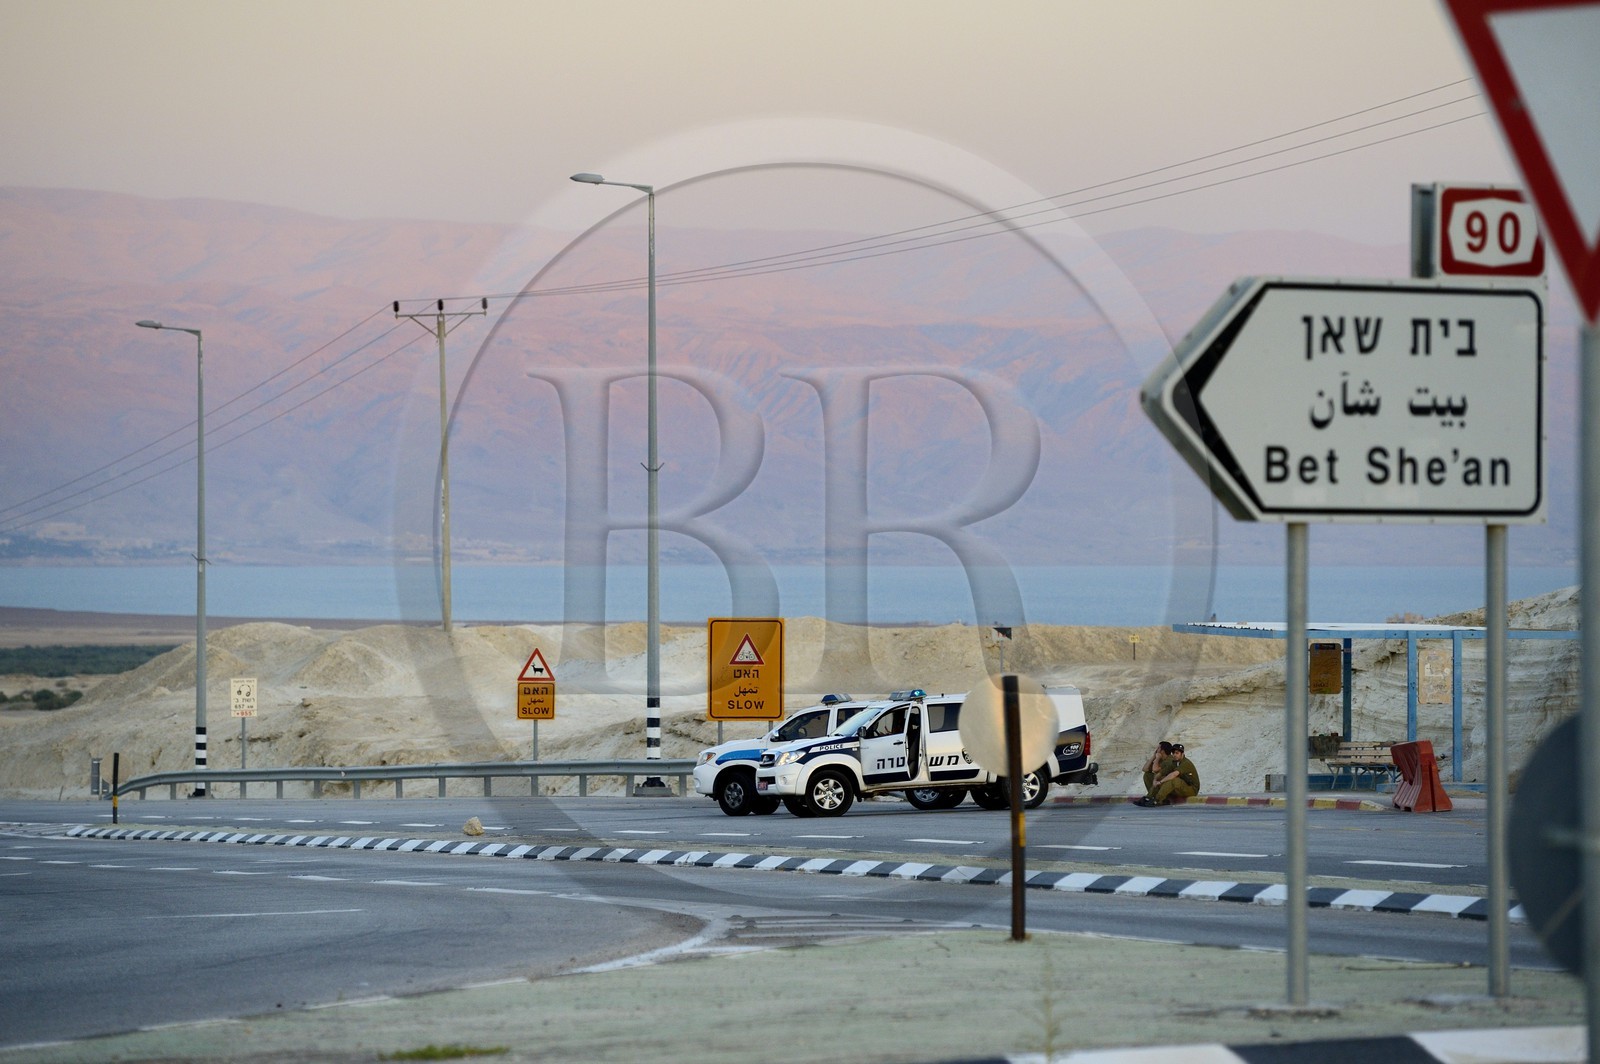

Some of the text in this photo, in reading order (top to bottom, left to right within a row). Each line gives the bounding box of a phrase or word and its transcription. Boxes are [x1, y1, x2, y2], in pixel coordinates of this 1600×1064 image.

[1464, 210, 1522, 255] 90
[1302, 315, 1477, 360] בית שאן
[1408, 386, 1469, 429] بيت
[1264, 445, 1512, 486] Bet She'an
[733, 669, 759, 679] האט
[521, 706, 550, 715] SLOW
[727, 700, 765, 710] SLOW
[819, 743, 844, 751] POLICE
